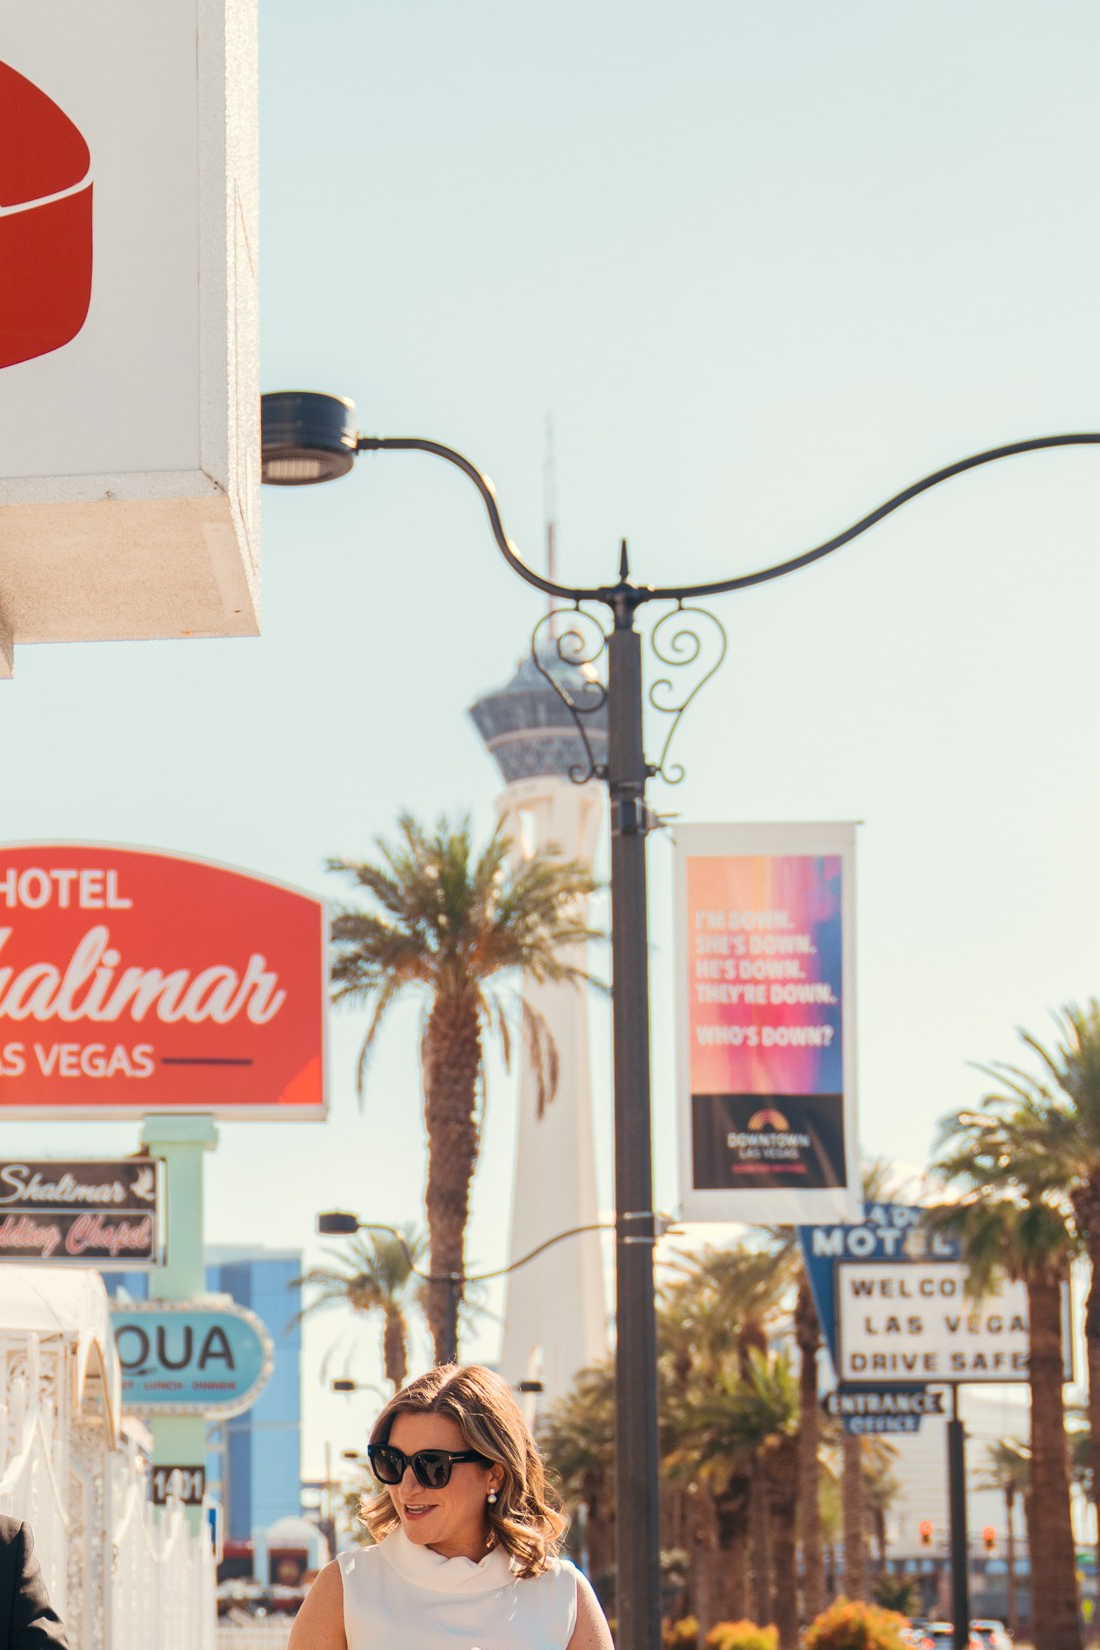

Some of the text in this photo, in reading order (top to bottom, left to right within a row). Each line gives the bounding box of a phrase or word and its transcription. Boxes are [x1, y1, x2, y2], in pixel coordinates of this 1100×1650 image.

[696, 911, 795, 929] I'M DOWN.
[696, 934, 818, 955] SHE'S DOWN.
[697, 959, 806, 979] HE'S DOWN.
[696, 983, 838, 1004] THEY'RE DOWN.
[697, 1024, 835, 1047] WHO'S DOWN?
[34, 1043, 155, 1078] VEGAS
[727, 1132, 810, 1149] DOWNTOWN
[739, 1147, 800, 1159] LAS VEGAS
[65, 1212, 151, 1257] Chapel
[812, 1226, 953, 1257] MOTEL
[851, 1278, 1006, 1297] WELCOE
[864, 1314, 1027, 1335] LAS VEGA
[113, 1324, 236, 1376] QUA
[850, 1351, 1028, 1373] DRIVE SAFE
